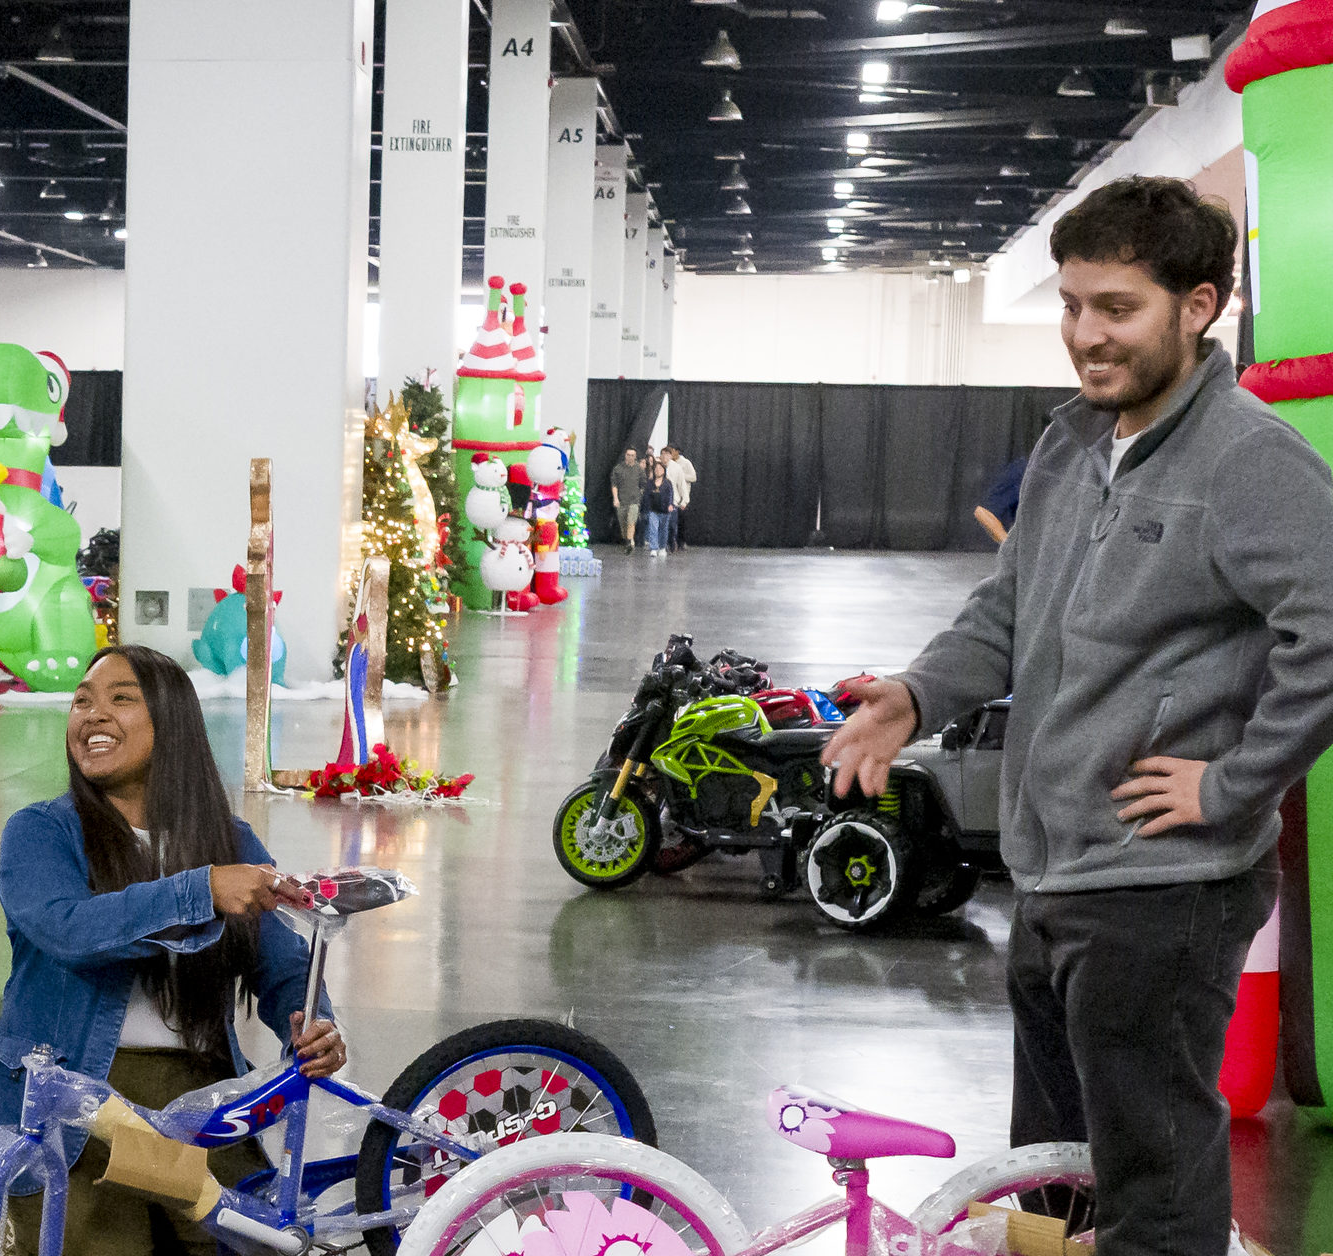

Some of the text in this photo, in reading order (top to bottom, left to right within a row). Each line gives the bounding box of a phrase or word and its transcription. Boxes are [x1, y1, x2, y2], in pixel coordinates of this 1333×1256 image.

[502, 37, 534, 57] A4
[412, 119, 431, 134] FIRE
[557, 127, 584, 143] A5
[389, 136, 453, 152] EXTINGUISHER
[594, 186, 616, 200] A6
[432, 1099, 558, 1169] G-SPOT
